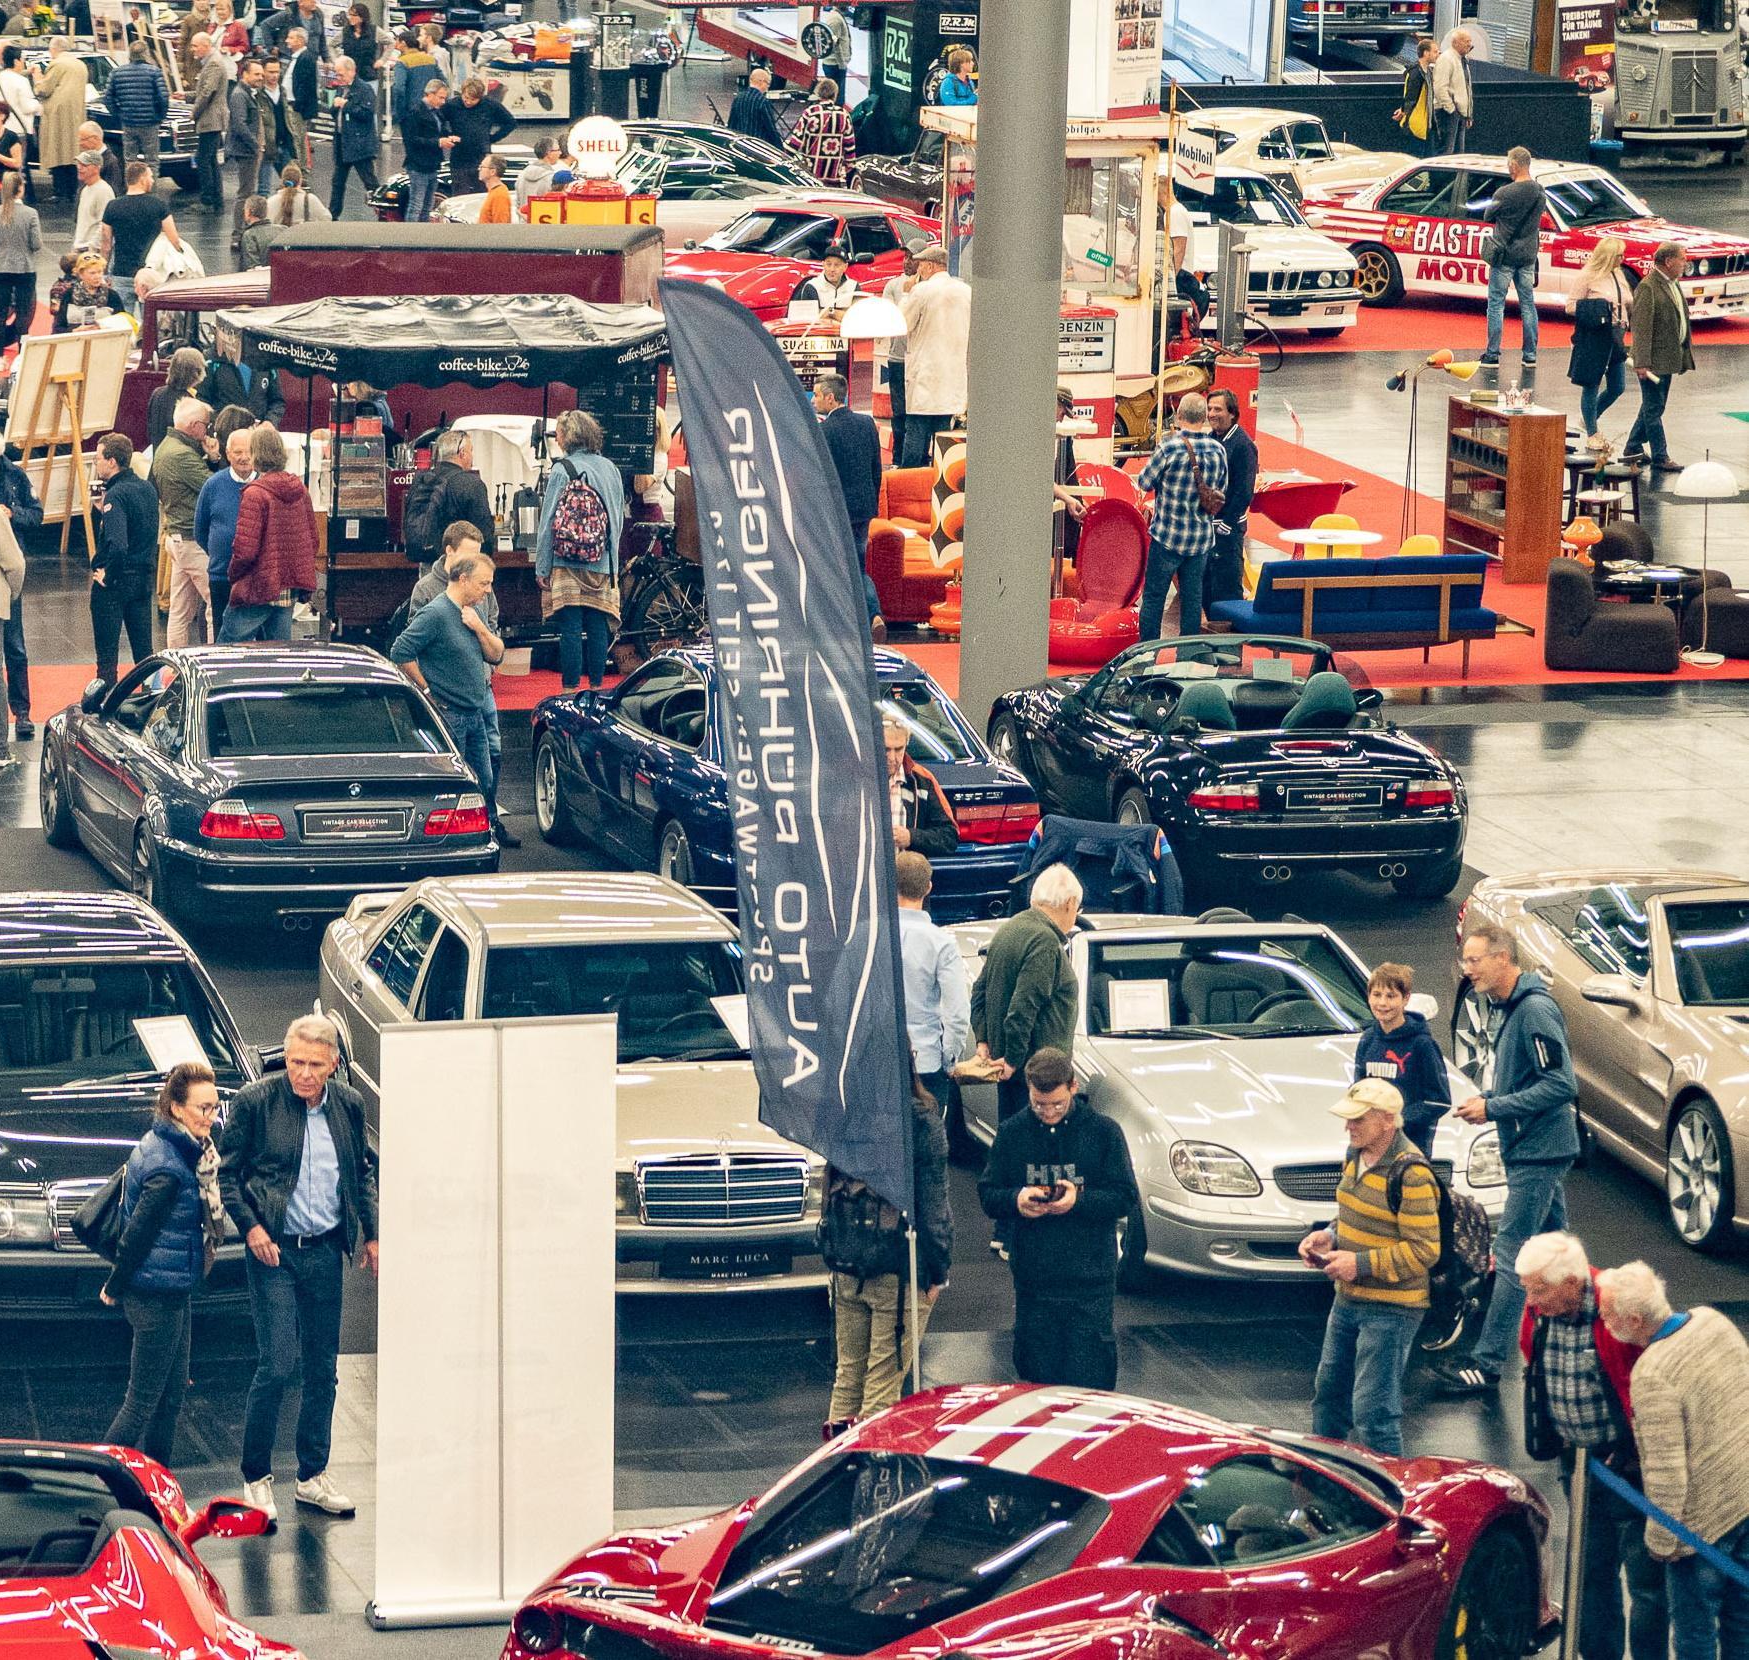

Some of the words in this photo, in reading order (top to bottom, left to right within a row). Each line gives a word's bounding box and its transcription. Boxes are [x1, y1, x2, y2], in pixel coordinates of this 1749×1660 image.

[1561, 9, 1601, 22] TREIBSTOFF
[1562, 21, 1576, 32] FÜR
[1576, 18, 1603, 30] TRÄUME
[1562, 32, 1590, 41] TANKEN!
[577, 140, 621, 152] SHELL
[1178, 142, 1213, 166] Mobiloil
[1413, 221, 1493, 256] BASTO
[1090, 252, 1109, 264] offen
[1416, 258, 1490, 285] MOTU
[258, 340, 312, 360] coffee-bike
[438, 357, 502, 371] coffee-bike
[393, 473, 415, 485] coff
[690, 1255, 729, 1265] MARC
[736, 1253, 770, 1263] LUCA
